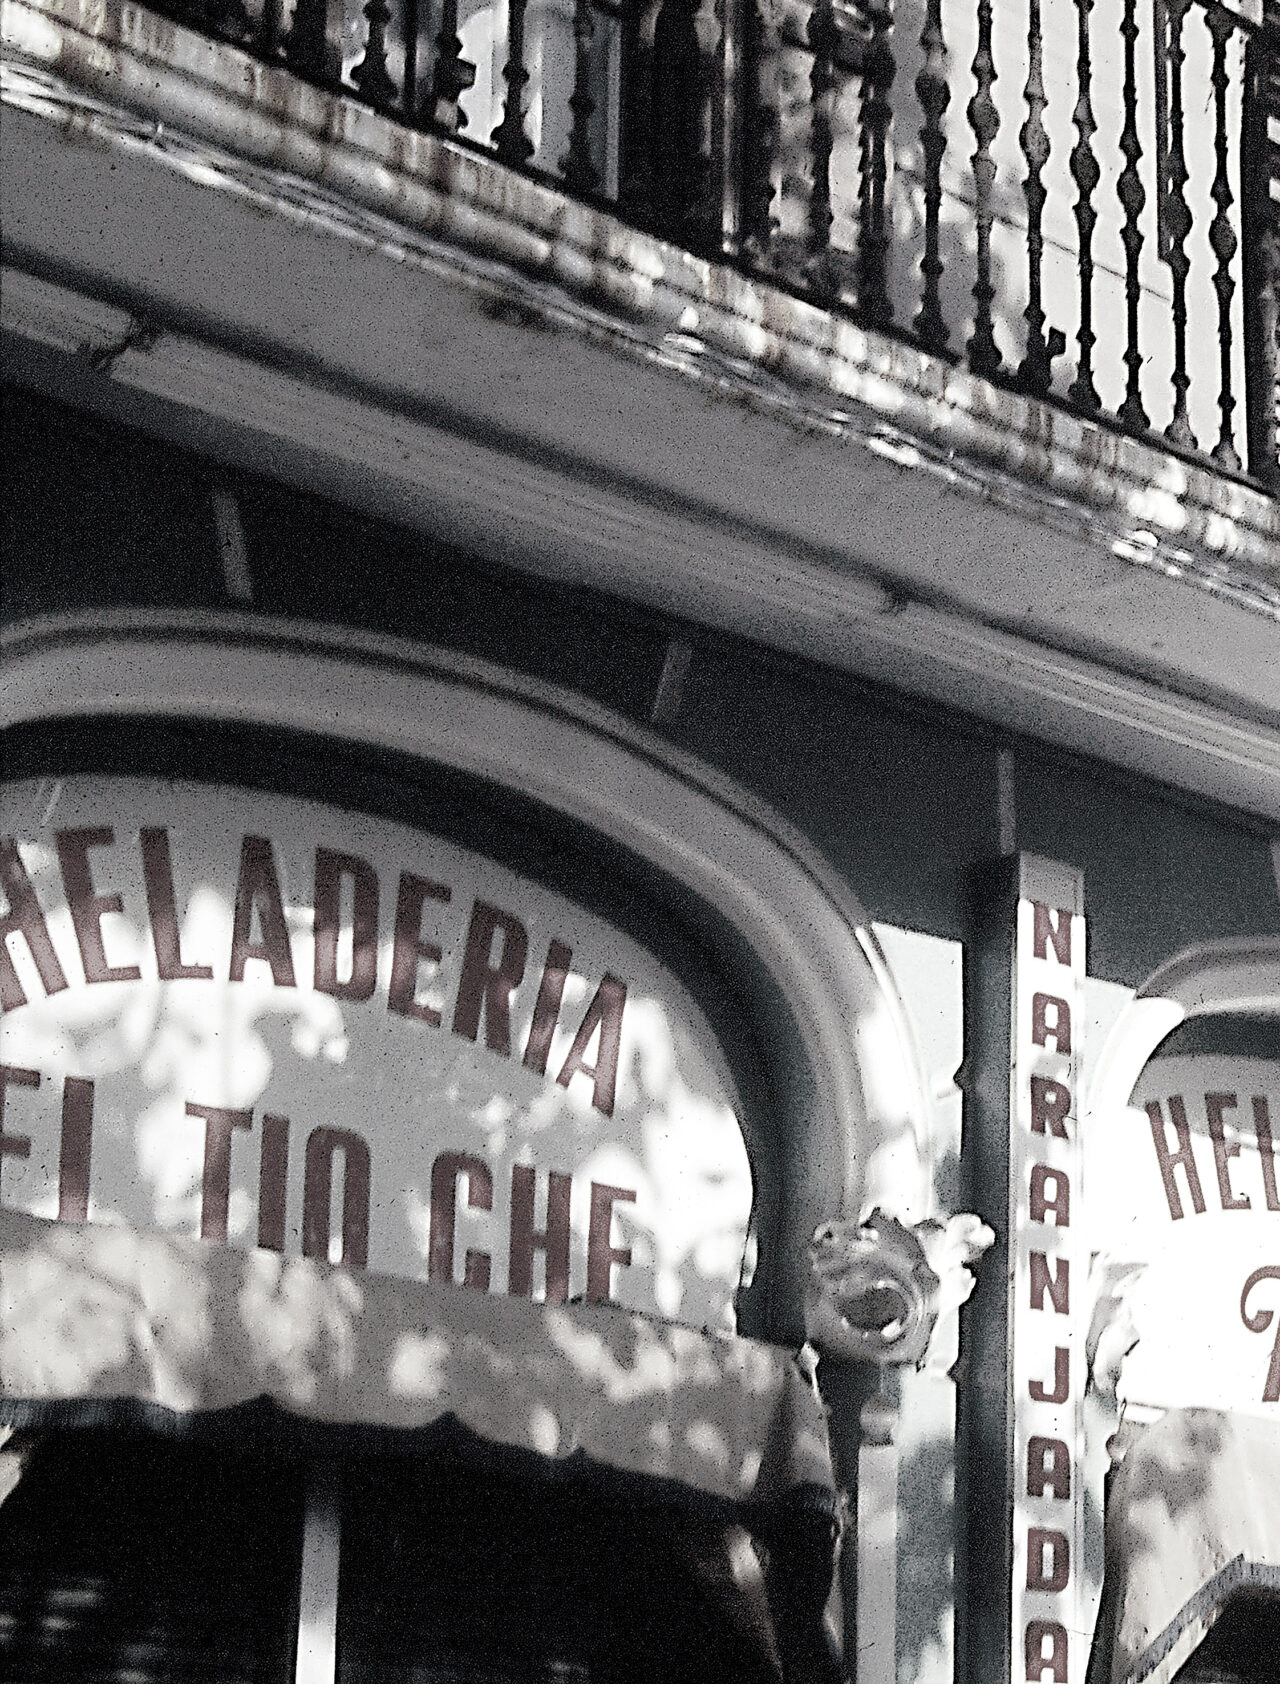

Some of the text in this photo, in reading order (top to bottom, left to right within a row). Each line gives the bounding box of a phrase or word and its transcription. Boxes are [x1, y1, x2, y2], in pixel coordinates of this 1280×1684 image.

[0, 826, 627, 1117] HELADERIA
[185, 1100, 371, 1272] TIO
[1024, 903, 1072, 1684] NARANJADA
